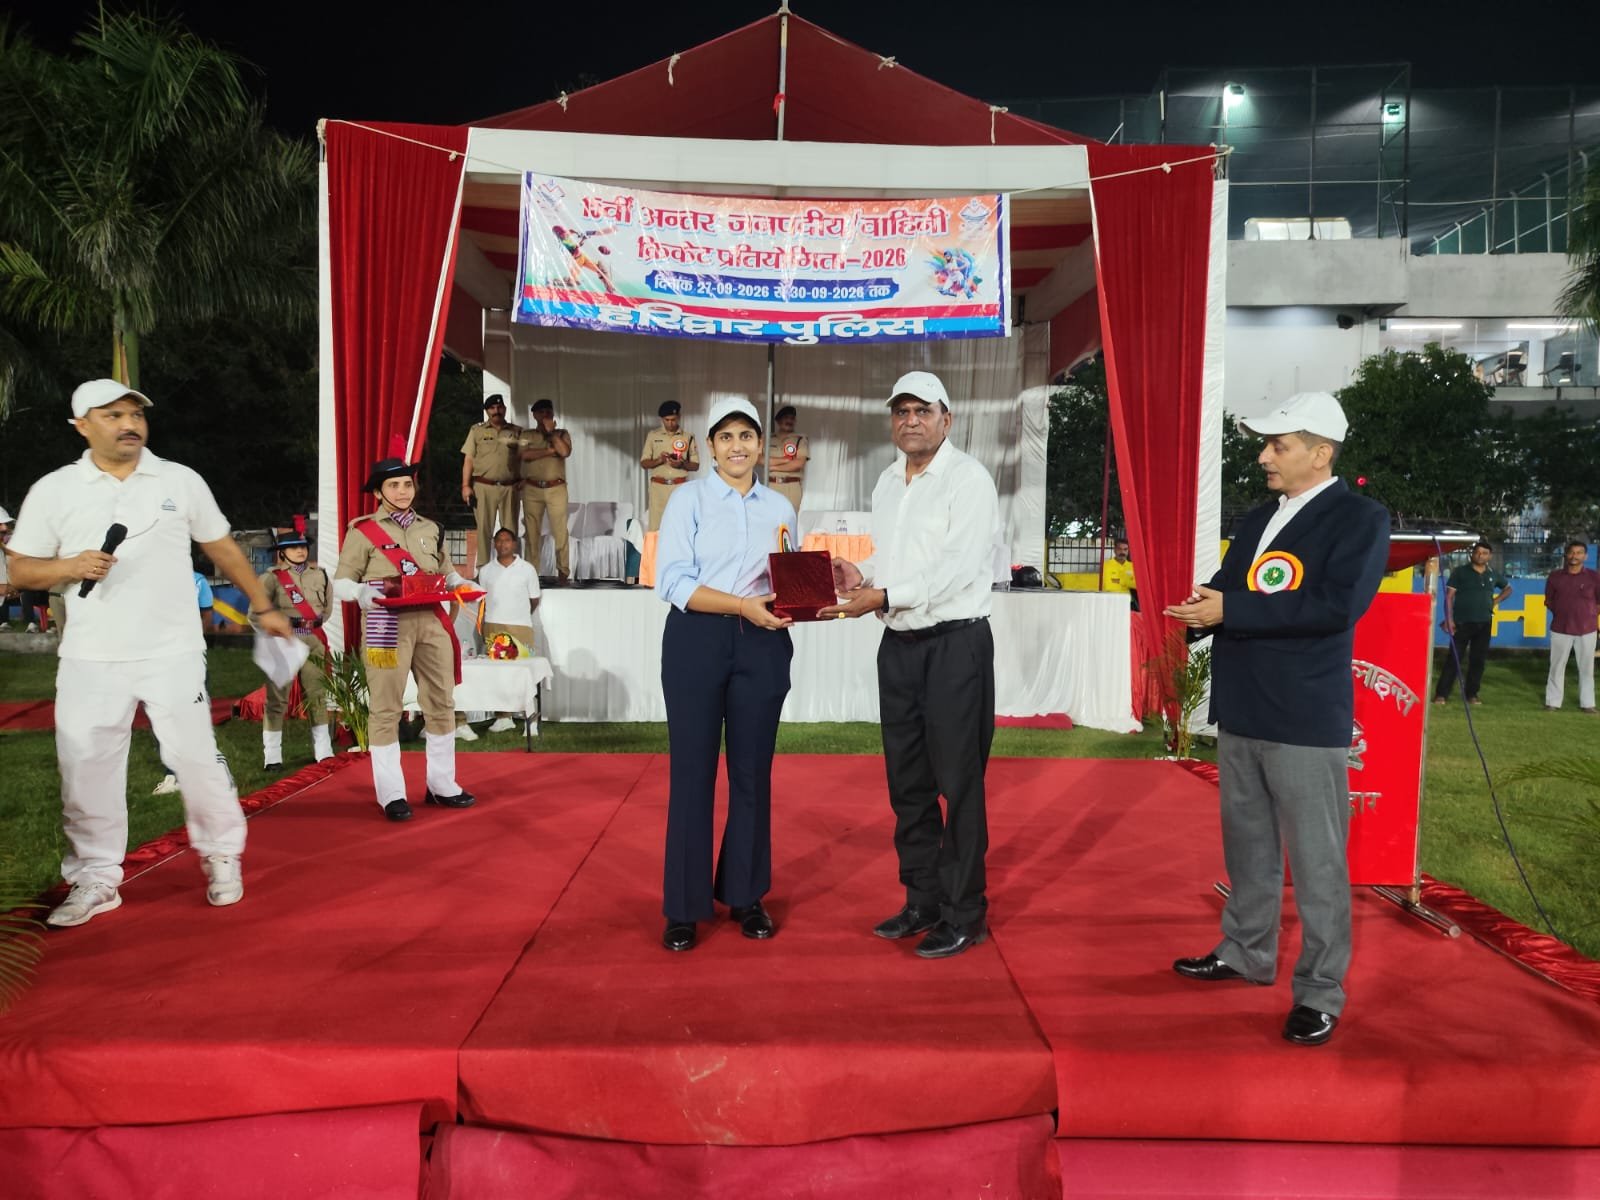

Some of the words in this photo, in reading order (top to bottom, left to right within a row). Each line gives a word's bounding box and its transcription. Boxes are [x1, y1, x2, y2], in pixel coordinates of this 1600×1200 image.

[640, 206, 714, 232] अन्तर
[638, 236, 712, 263] क्रिकेट
[655, 274, 693, 292] दिनांक
[697, 280, 769, 298] 27-09-2026
[790, 284, 865, 299] 30-09-2026
[868, 284, 891, 298] तक
[598, 303, 769, 335] हरिद्वार
[779, 313, 928, 344] पुलिस
